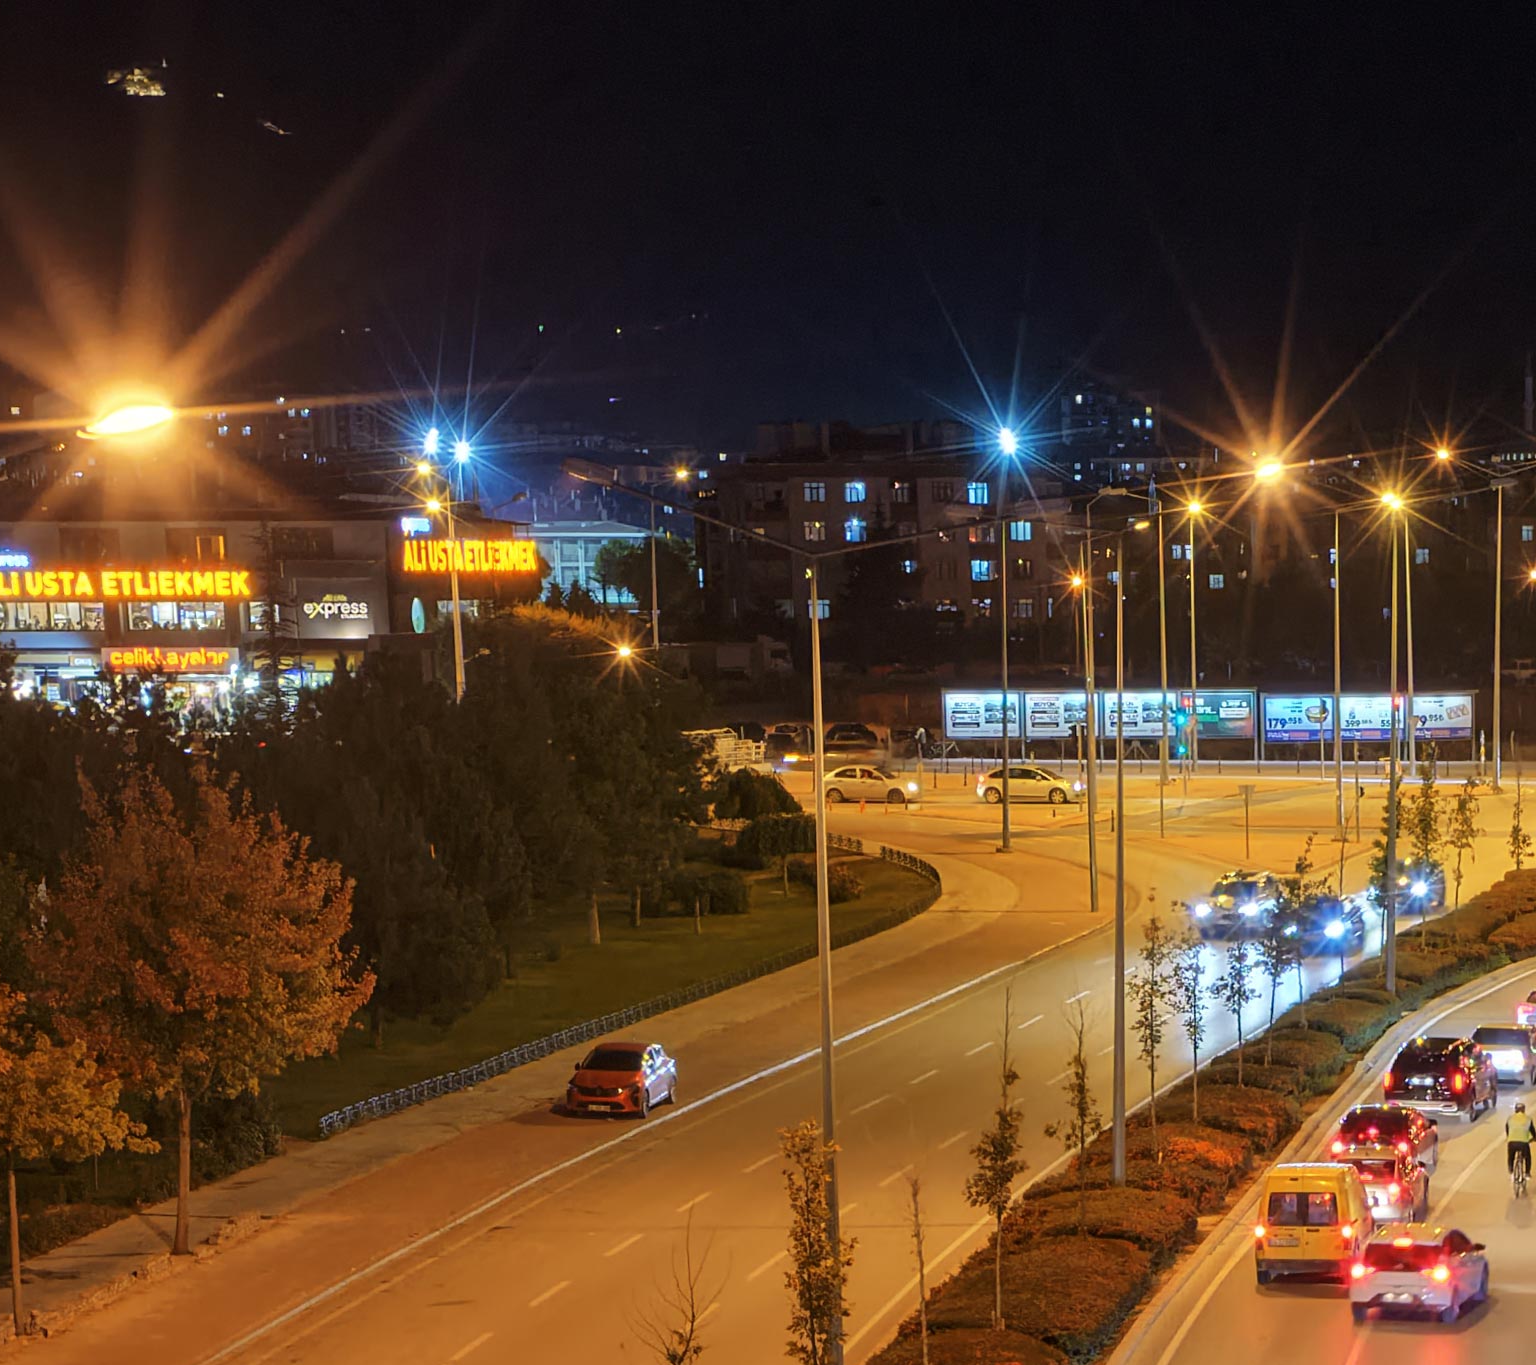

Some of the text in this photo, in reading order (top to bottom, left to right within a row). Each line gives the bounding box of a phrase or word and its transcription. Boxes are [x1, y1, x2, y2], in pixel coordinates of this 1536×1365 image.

[427, 540, 463, 572] USTA
[25, 571, 93, 596] USTA
[303, 601, 369, 619] express
